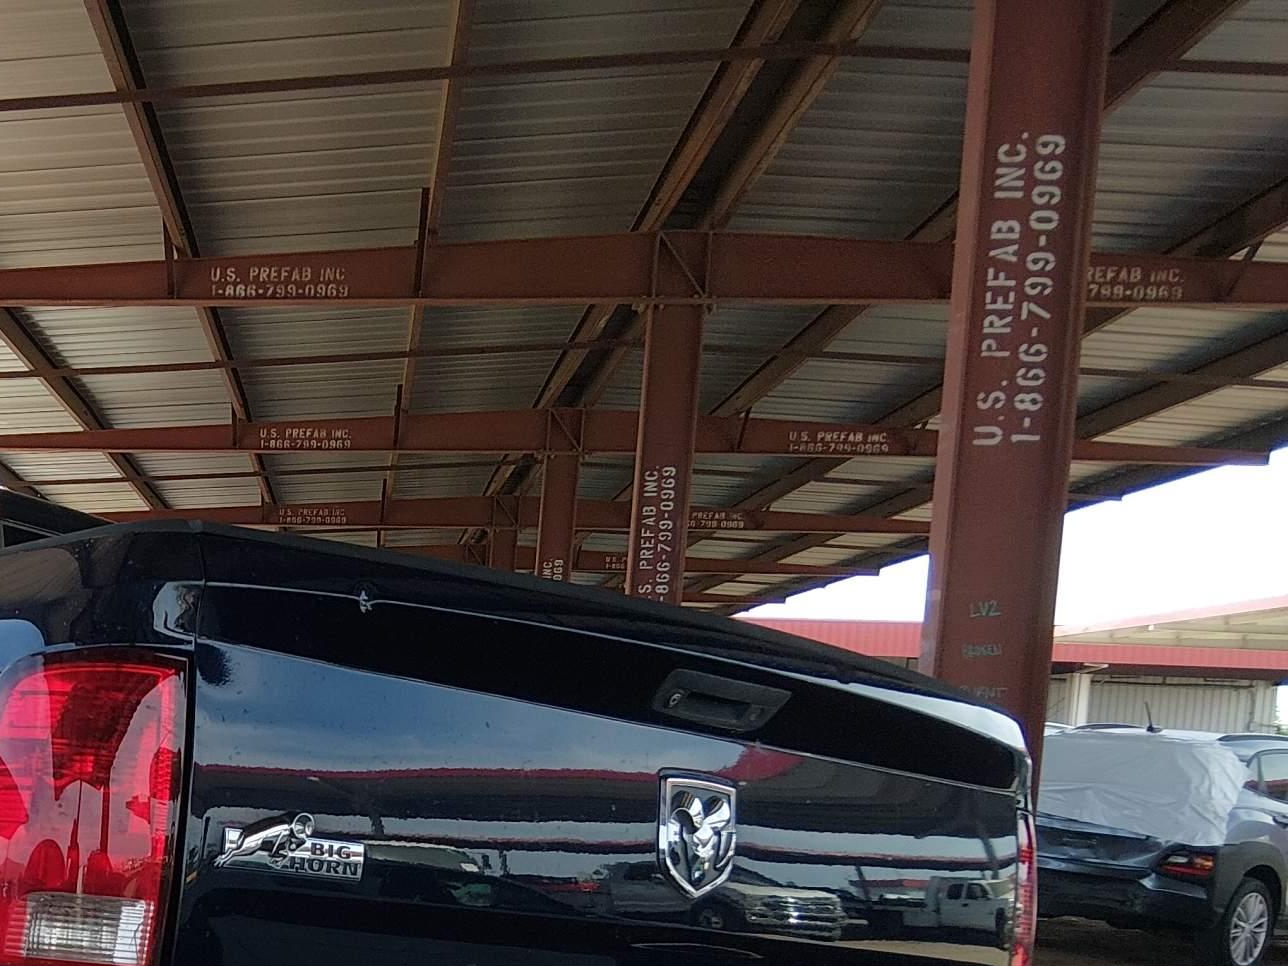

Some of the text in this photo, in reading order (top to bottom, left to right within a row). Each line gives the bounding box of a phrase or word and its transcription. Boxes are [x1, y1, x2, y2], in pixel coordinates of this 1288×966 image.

[210, 267, 241, 282] U.S.
[249, 267, 312, 282] PREFAB
[1150, 268, 1184, 283] INC.
[211, 284, 349, 298] 1-866-799-0969
[972, 131, 1030, 446] U.S. PREFAB INC.
[1011, 133, 1067, 443] 1-866-799-0969
[259, 428, 352, 439] U.S. PREFAB INC.
[816, 432, 863, 442] PREFAB
[260, 440, 352, 449] 1-866-799-0969
[638, 465, 660, 599] .S. PREFAB INC.
[655, 466, 677, 602] -866-799-0969
[310, 842, 351, 860] BIG
[288, 857, 362, 876] HORN
